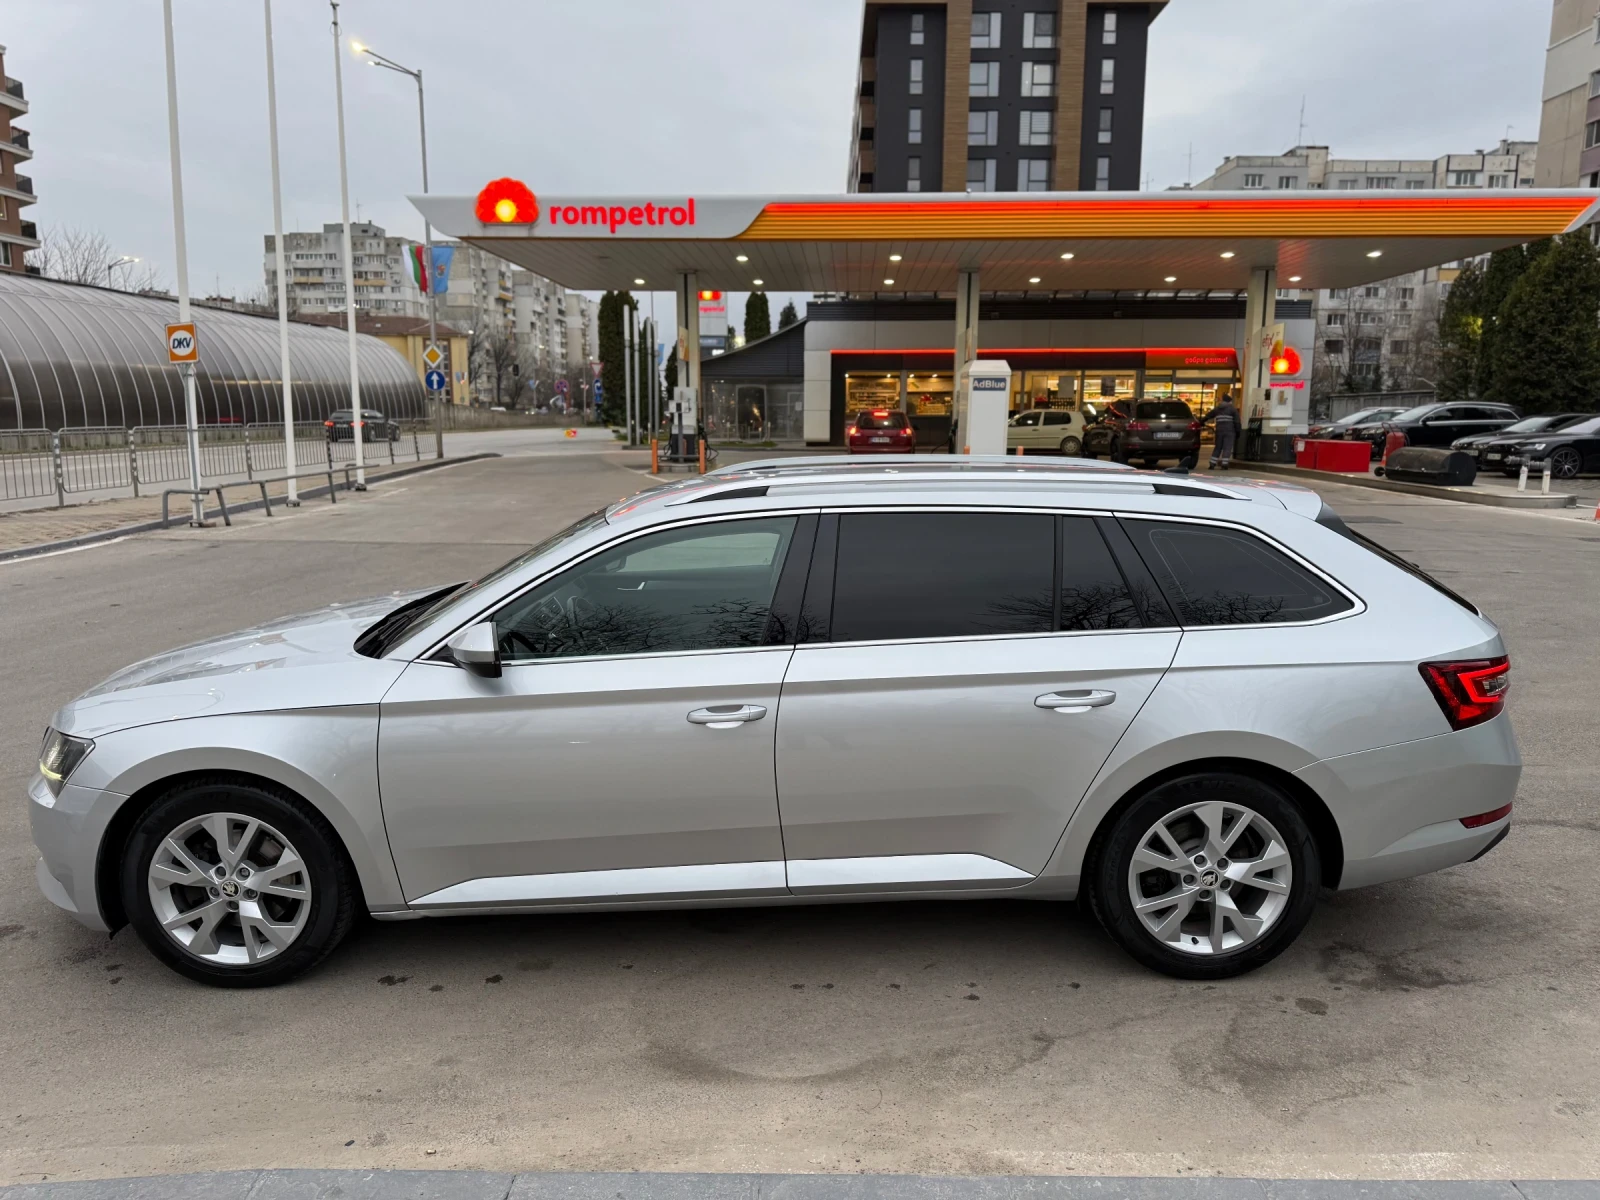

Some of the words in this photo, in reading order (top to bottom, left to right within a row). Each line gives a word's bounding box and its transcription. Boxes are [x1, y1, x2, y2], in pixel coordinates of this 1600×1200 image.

[550, 198, 695, 234] rompetrol
[172, 337, 192, 349] DKV
[973, 379, 1006, 389] AdBlue
[1272, 440, 1278, 453] 5
